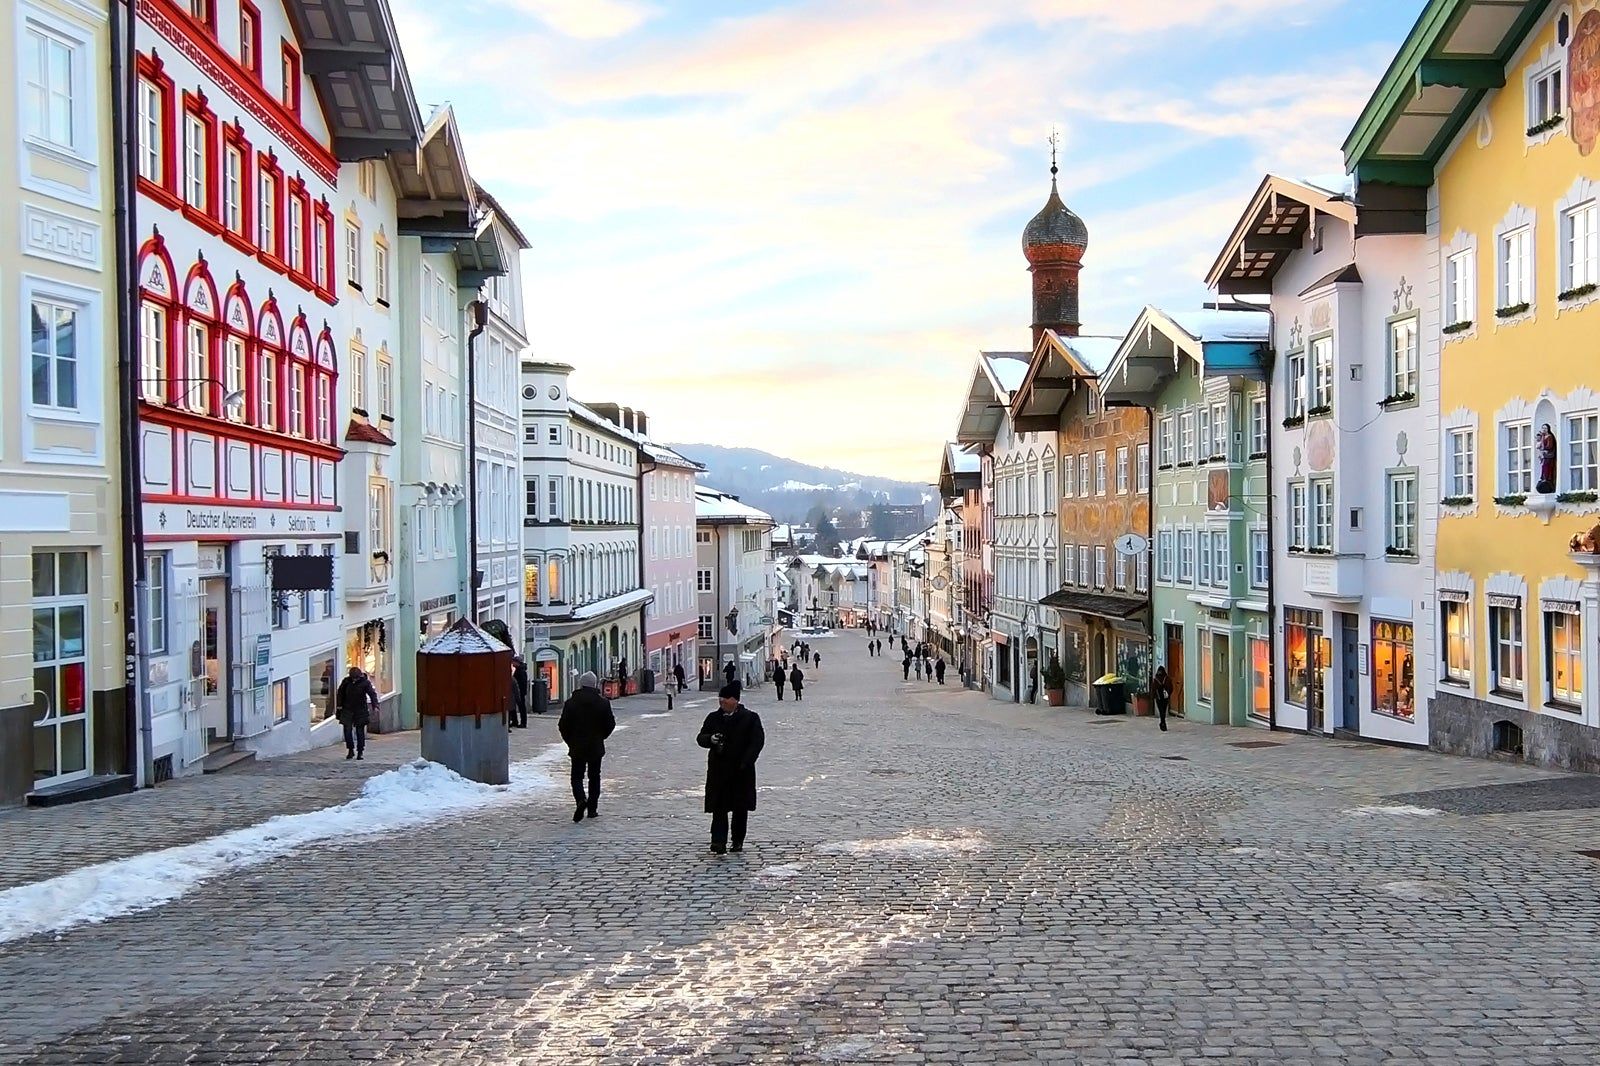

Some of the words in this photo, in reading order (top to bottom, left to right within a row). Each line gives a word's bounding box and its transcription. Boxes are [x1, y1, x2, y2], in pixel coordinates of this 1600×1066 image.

[186, 509, 220, 529] Deutscher
[222, 510, 257, 532] Alpenverein
[288, 515, 306, 531] Sektion
